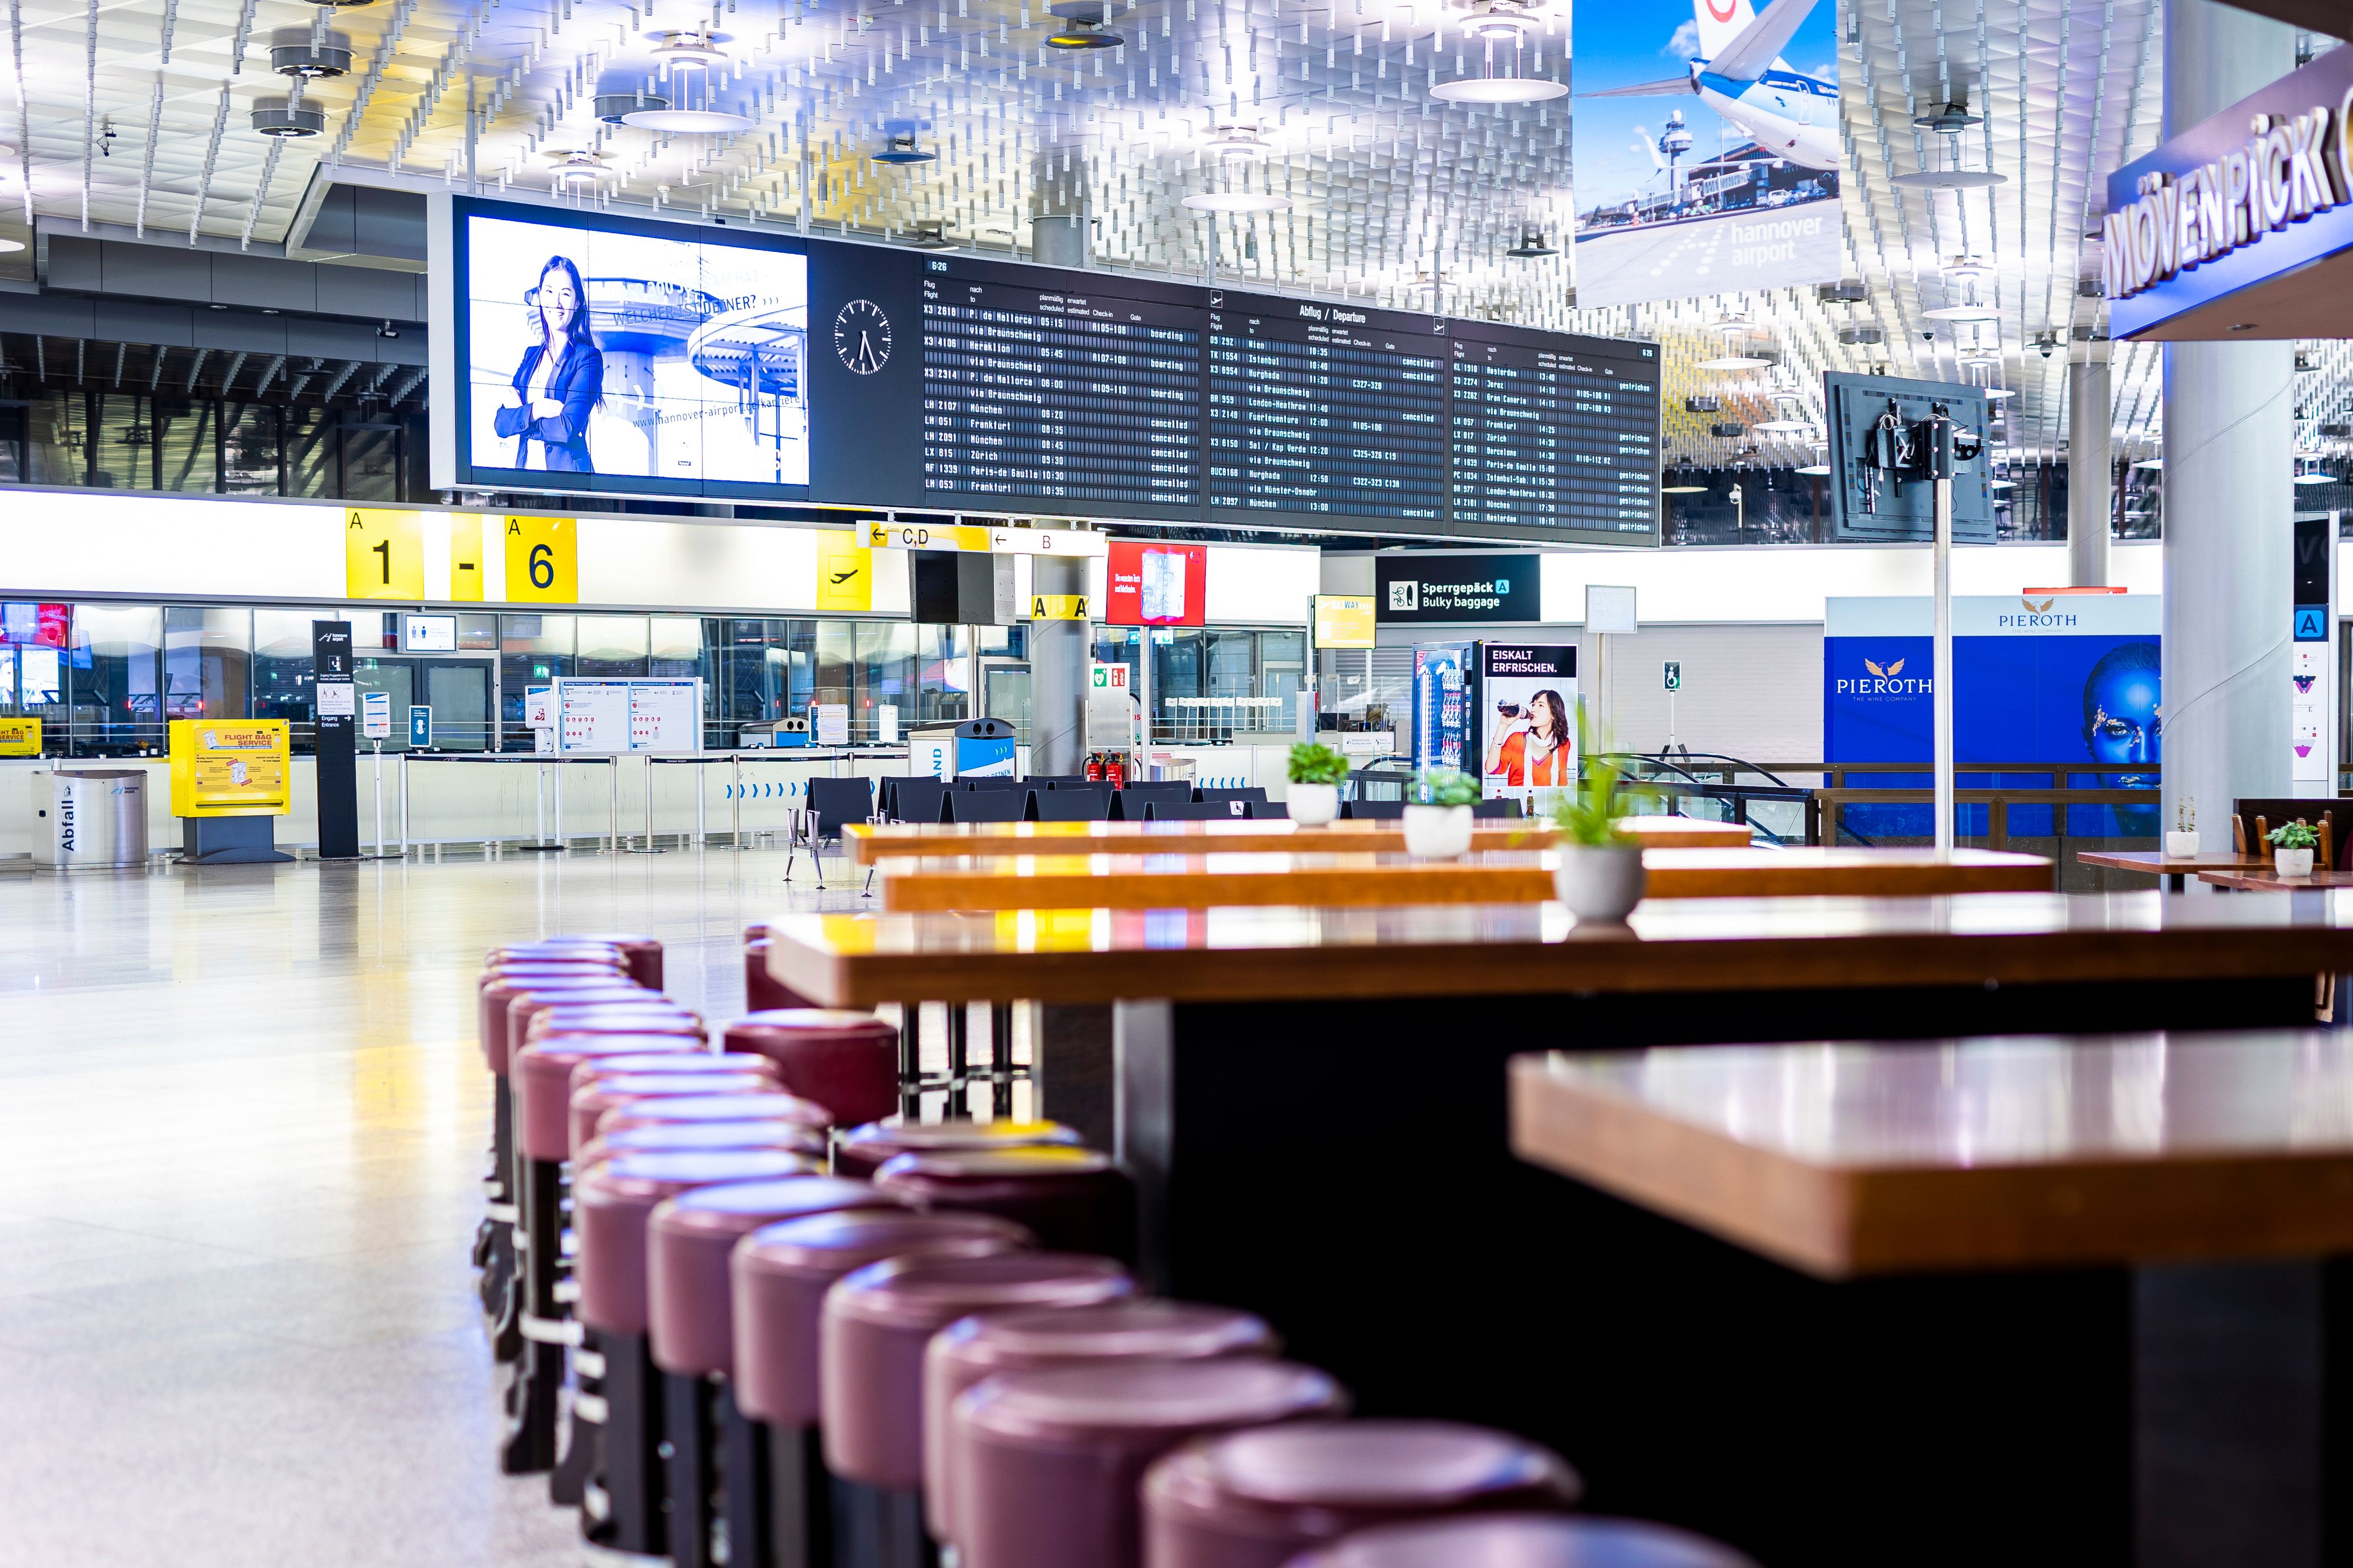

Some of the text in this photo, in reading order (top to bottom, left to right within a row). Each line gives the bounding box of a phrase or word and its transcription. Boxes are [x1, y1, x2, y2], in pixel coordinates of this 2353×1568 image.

[1731, 216, 1822, 243] hannover
[1732, 240, 1796, 268] airport
[932, 262, 946, 271] 6:26
[924, 281, 935, 289] Flug
[1039, 294, 1063, 303] planmäßig
[613, 306, 675, 326] WELCHER
[677, 302, 699, 318] IST
[924, 291, 938, 299] Flight
[1039, 304, 1064, 312] scheduled
[1093, 309, 1113, 318] Check-in
[1299, 305, 1321, 319] Abflug
[1334, 309, 1365, 323] Departure
[924, 305, 933, 313] X3
[969, 309, 978, 319] P.
[983, 312, 992, 320] de
[997, 312, 1032, 324] Mallorca
[1041, 317, 1063, 328] 05:15
[1151, 329, 1183, 342] boarding
[970, 326, 1041, 342] via Braunschweig
[924, 336, 933, 345] X3
[938, 338, 956, 348] 4106
[970, 341, 1010, 353] Heraklion
[1041, 348, 1063, 358] 05:45
[1151, 359, 1183, 371] boarding
[1211, 351, 1434, 382] TK 1554 Istanbul 10:40 cancelled
[1211, 365, 1218, 373] X3
[1222, 366, 1238, 375] 6954
[1249, 369, 1279, 380] Hurghada
[1309, 375, 1328, 384] 11:20
[1265, 385, 1309, 398] Braunschweig
[1454, 376, 1460, 385] X3
[1464, 378, 1477, 386] 2274
[1487, 380, 1504, 389] Jerez
[1539, 386, 1555, 394] 14:10
[633, 396, 799, 428] www.hannover-airport.de/karriere
[925, 399, 1188, 429] LH 2107 München 06:20 cancelled
[925, 415, 1188, 444] LH 051 Frankfurt 08:35 cancelled
[925, 448, 934, 456] LX
[971, 451, 998, 461] Zürich
[1042, 456, 1064, 465] 09:30
[1152, 463, 1188, 473] cancelled
[925, 463, 1188, 488] AF 1339 Paris-de Gaulle 10:30 cancelled
[1487, 461, 1513, 469] Paris-de
[1517, 463, 1535, 472] Gaulle
[1539, 465, 1554, 473] 15:00
[1619, 472, 1649, 481] gestrichen
[349, 513, 521, 535] A A
[903, 529, 928, 547] C,D
[1042, 536, 1051, 549] B
[372, 540, 390, 584] 1
[529, 544, 554, 589] 6
[1422, 582, 1507, 595] Sperrgepäck A
[1034, 598, 1046, 618] A
[1075, 598, 1086, 618] A
[1423, 596, 1499, 609] Bulky baggage
[1999, 615, 2077, 626] PIEROTH
[2301, 614, 2318, 633] A
[1493, 650, 1532, 660] EISKALT
[1493, 663, 1557, 672] ERFRISCHEN.
[1837, 679, 1932, 693] PIEROTH
[62, 800, 74, 852] Abfall
